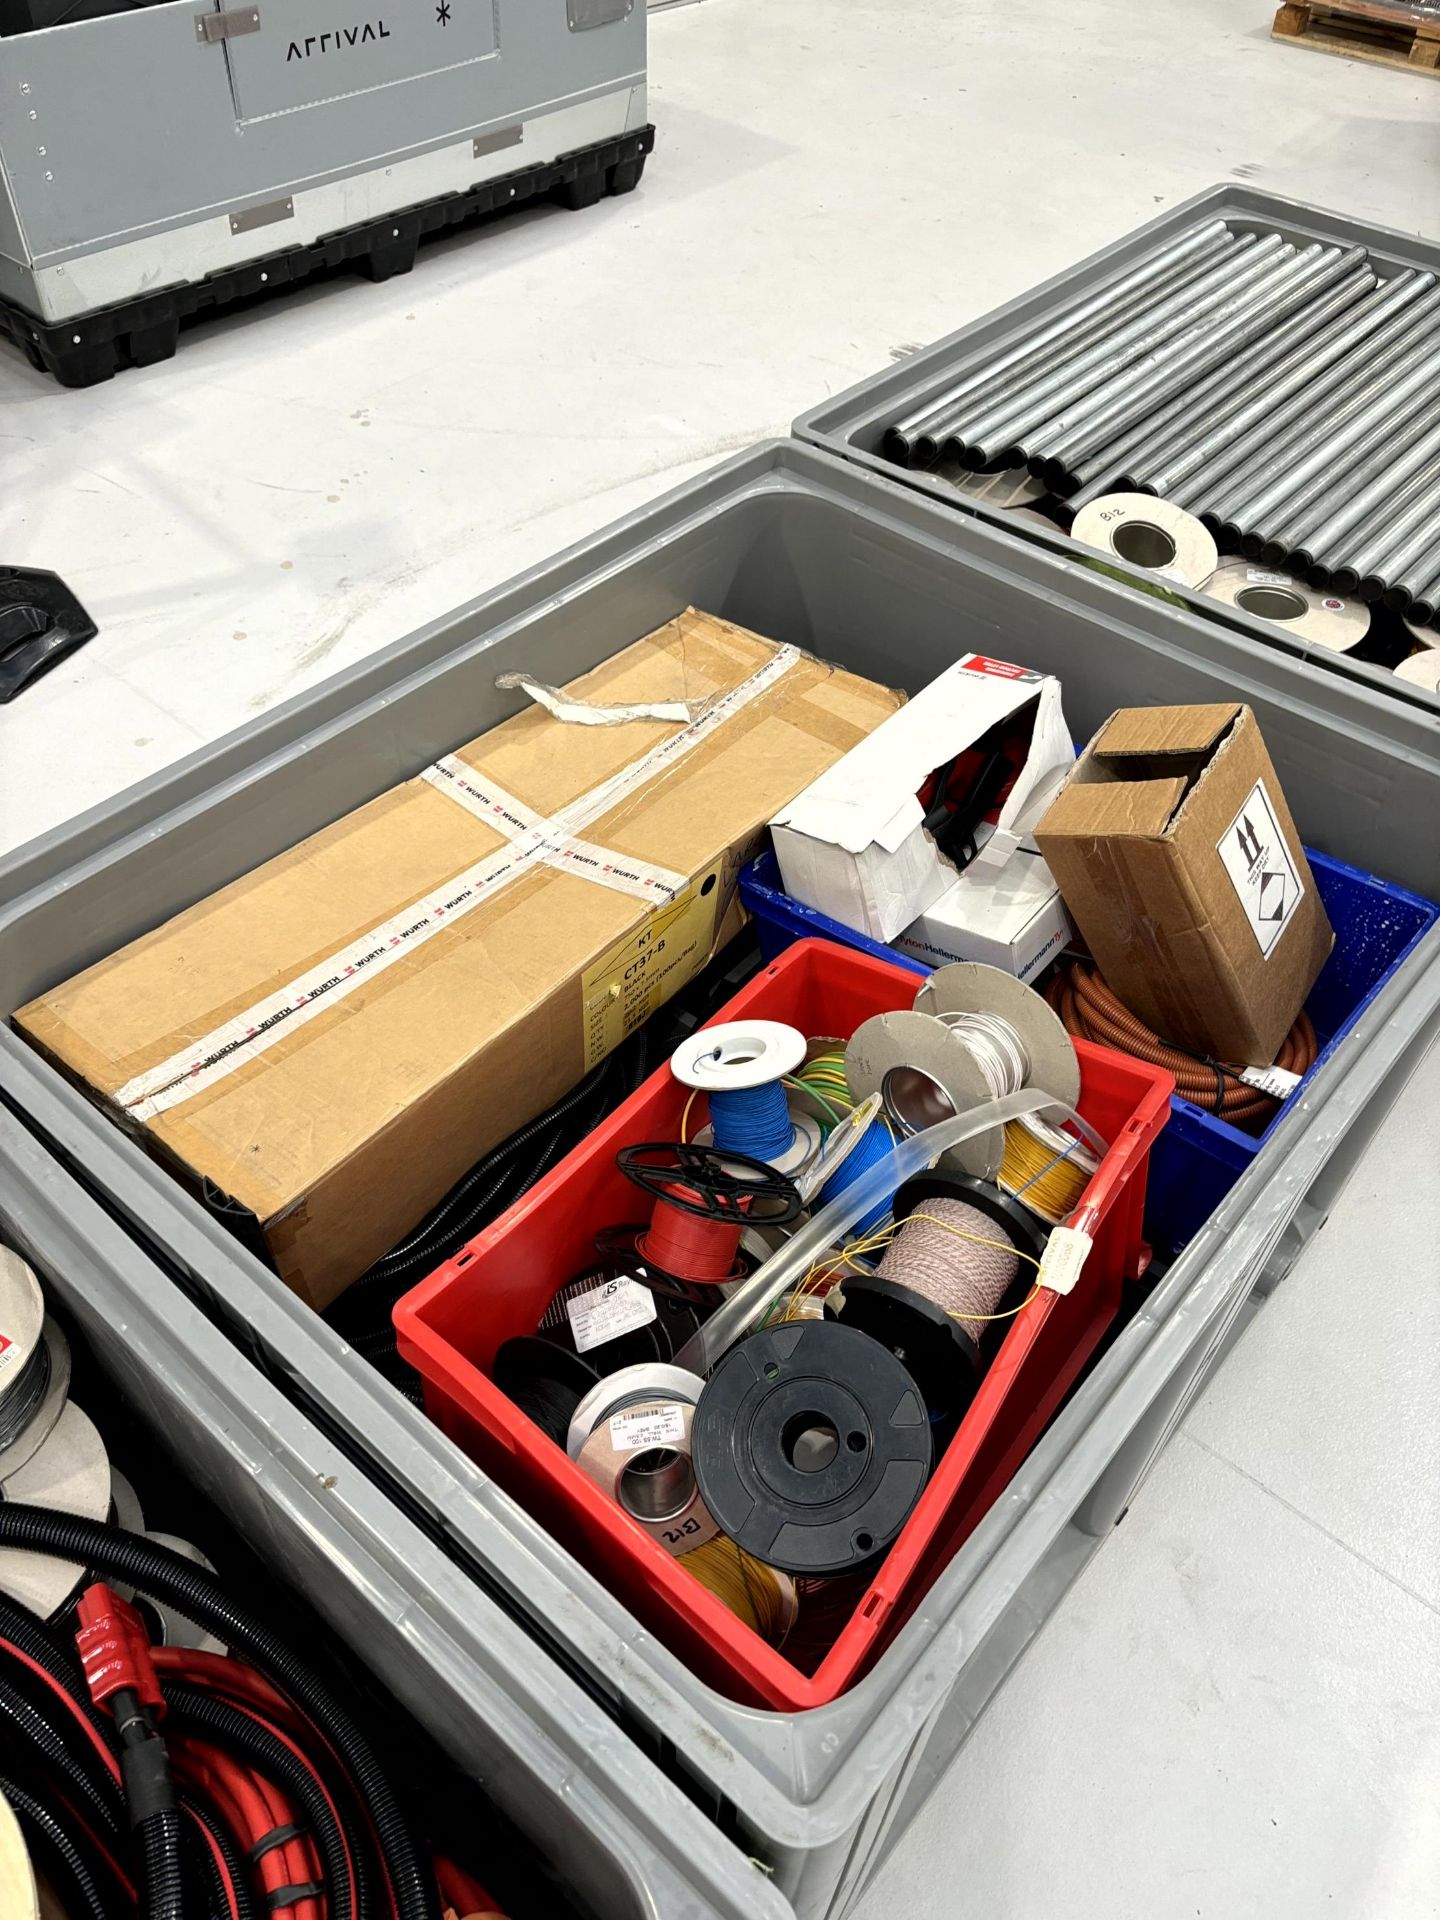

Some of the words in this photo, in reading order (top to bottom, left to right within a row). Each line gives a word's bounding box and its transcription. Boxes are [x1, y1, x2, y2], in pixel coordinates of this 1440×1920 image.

[1100, 508, 1125, 521] B12
[466, 786, 491, 804] WURTH
[502, 812, 528, 830] WURTH
[573, 854, 599, 866] WURTH
[612, 868, 640, 881] WURTH
[444, 890, 472, 910] WURTH
[400, 918, 430, 939] WURTH
[638, 930, 652, 948] KT
[354, 946, 386, 968] WURTH
[624, 940, 666, 980] CT37-B
[308, 976, 340, 999] WURTH
[624, 969, 645, 993] BLACK
[258, 1006, 292, 1030] WURTH
[662, 1518, 701, 1543] B12
